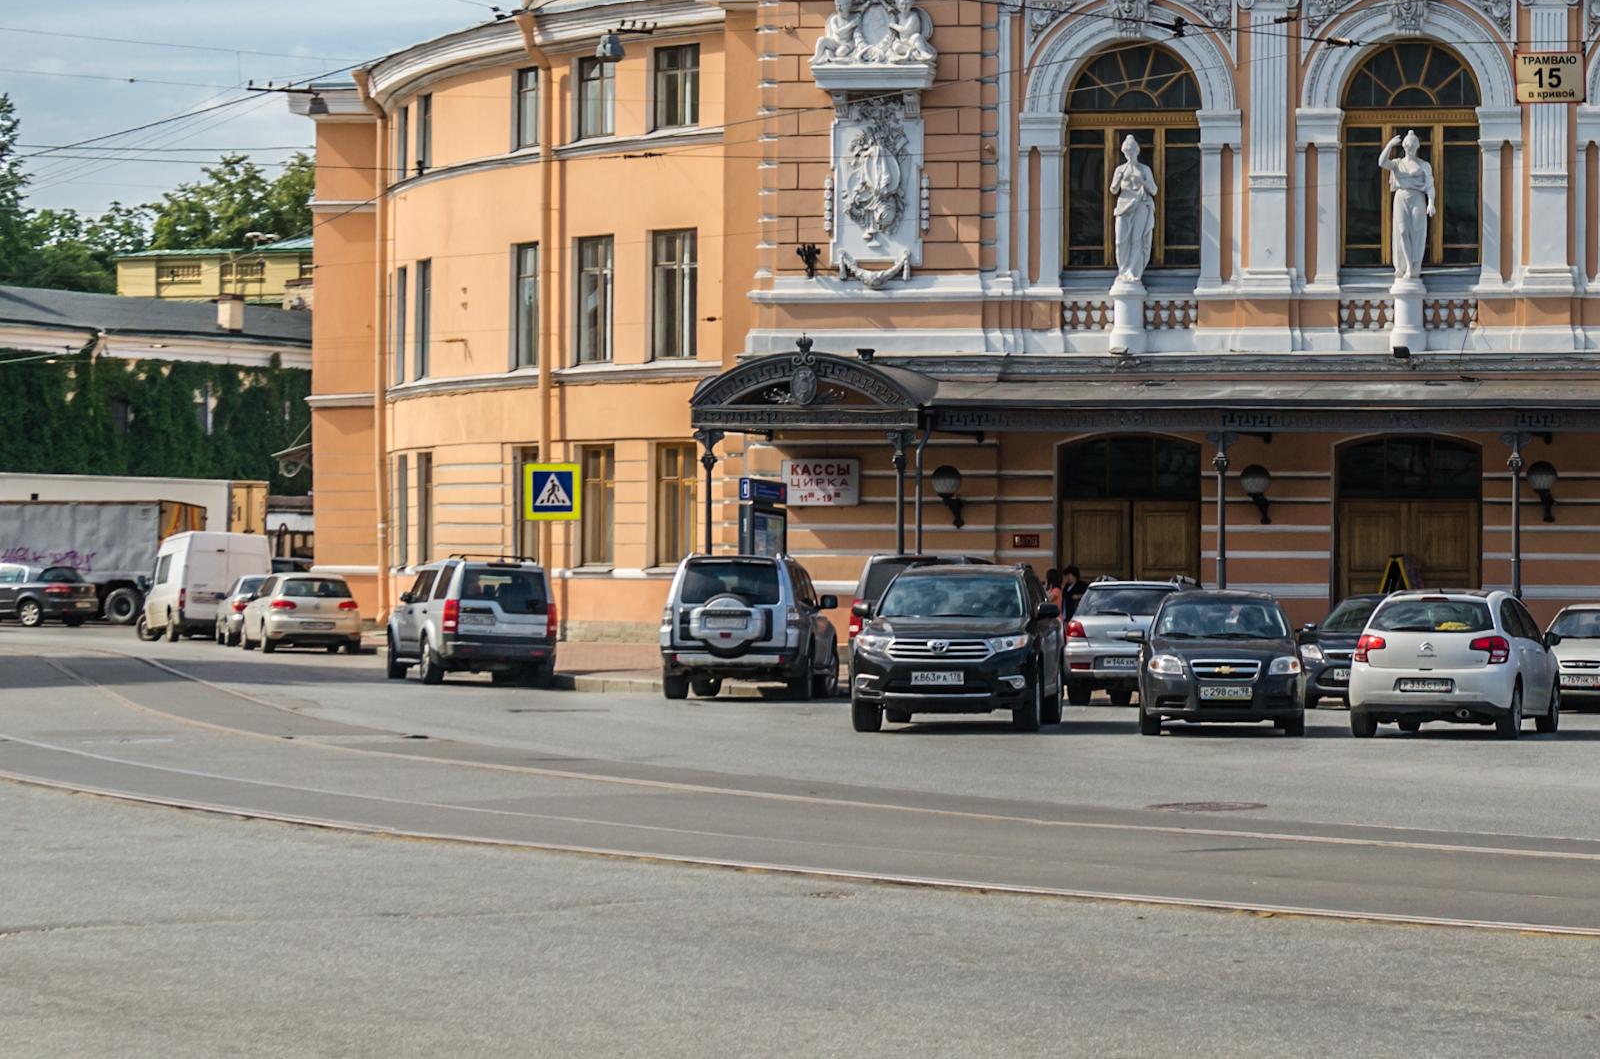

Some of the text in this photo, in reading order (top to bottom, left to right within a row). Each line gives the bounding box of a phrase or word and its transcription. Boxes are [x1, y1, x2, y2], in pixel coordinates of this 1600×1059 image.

[1522, 55, 1577, 65] ТРАМВАЮ
[1534, 67, 1562, 88] 15
[1537, 89, 1575, 100] кривой
[791, 463, 850, 476] КАССЫ
[790, 478, 849, 488] ЦИРКА
